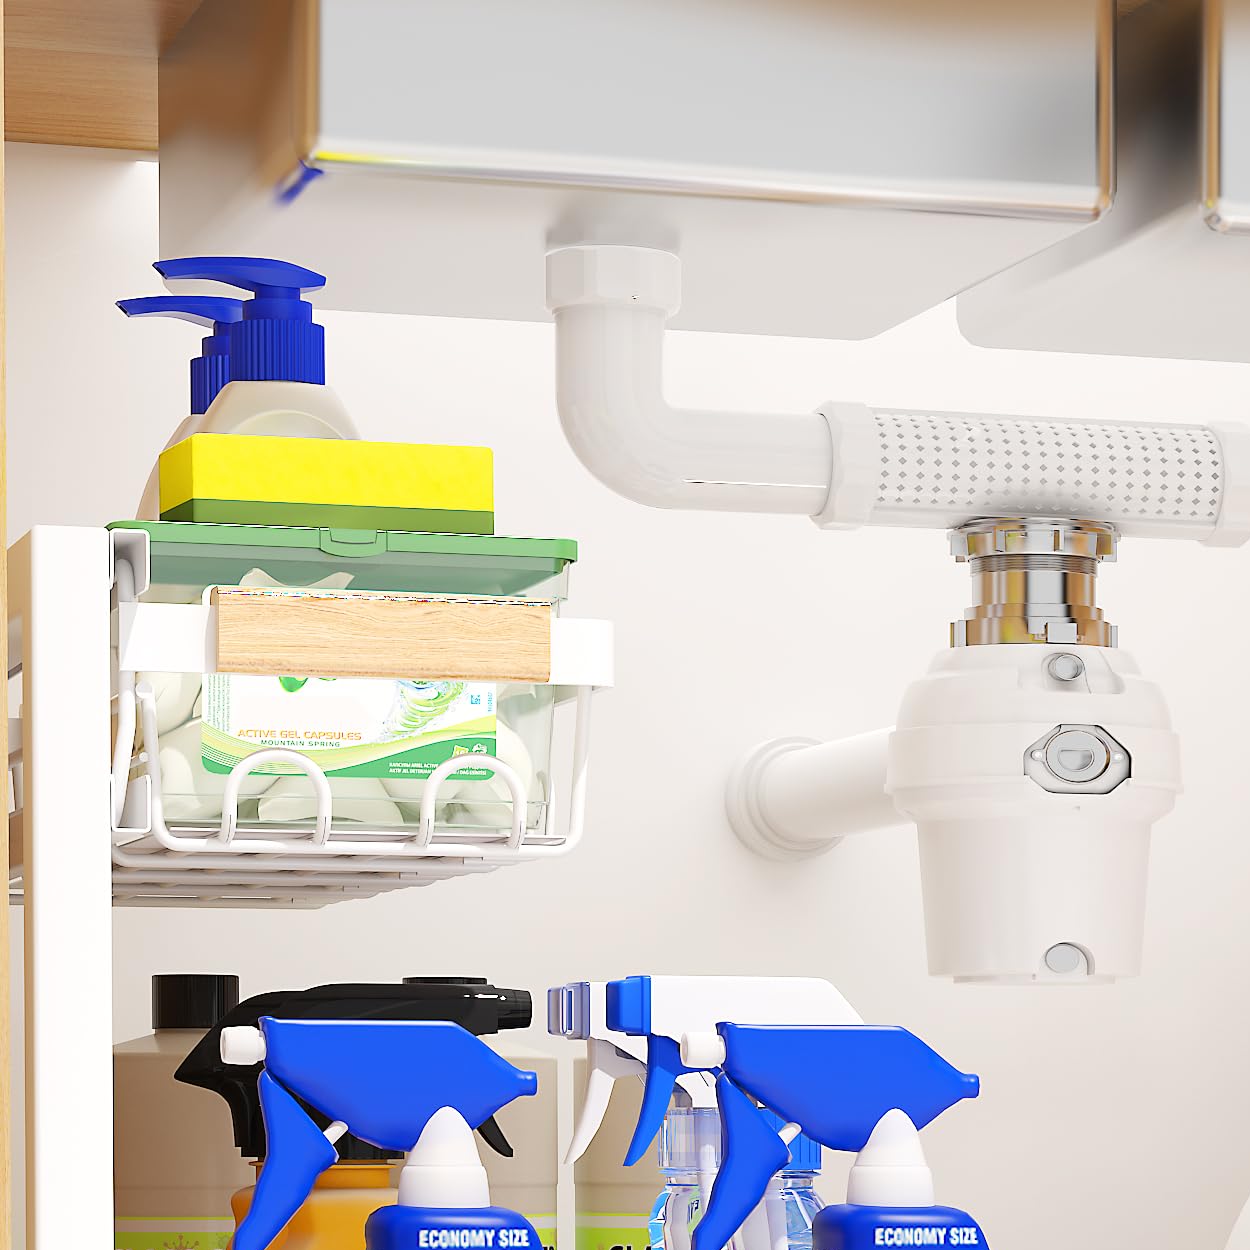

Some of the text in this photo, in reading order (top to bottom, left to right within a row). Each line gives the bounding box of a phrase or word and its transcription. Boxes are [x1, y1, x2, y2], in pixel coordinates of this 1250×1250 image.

[237, 729, 361, 740] ACTIVE GEL CAPSULES
[419, 1229, 530, 1248] ECONOMY SIZE
[874, 1227, 979, 1246] ECONOMY SIZE
